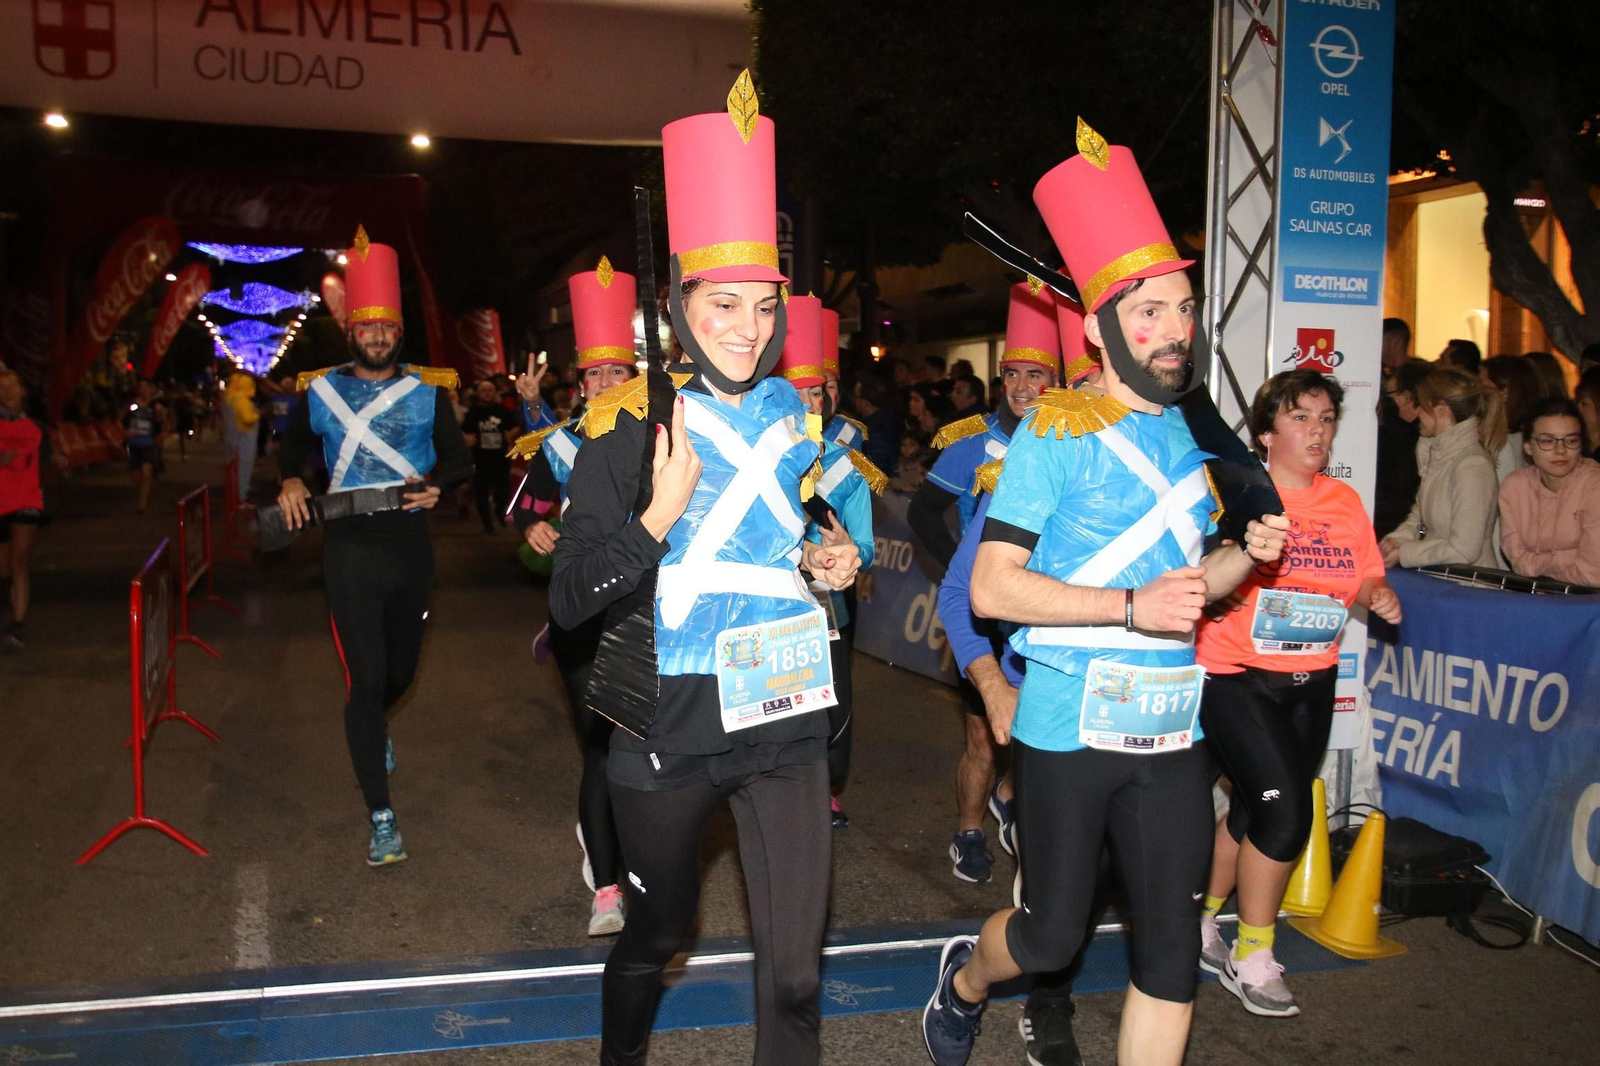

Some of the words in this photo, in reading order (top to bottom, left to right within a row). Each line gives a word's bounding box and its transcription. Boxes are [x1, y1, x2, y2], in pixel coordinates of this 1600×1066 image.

[194, 45, 364, 90] CIUDAD
[1321, 82, 1350, 96] OPEL
[1293, 167, 1306, 178] DS
[1309, 168, 1375, 184] AUTOMOBILES
[1310, 201, 1354, 216] GRUPO
[1289, 218, 1343, 234] SALINAS
[1346, 222, 1372, 236] CAR
[1294, 274, 1368, 292] DECATHLON
[1284, 546, 1352, 557] ARRERA
[1290, 611, 1340, 630] 2203
[767, 638, 824, 675] 1853
[766, 667, 815, 691] MAGDALENA
[1136, 690, 1196, 716] 1817
[1333, 699, 1355, 711] ería
